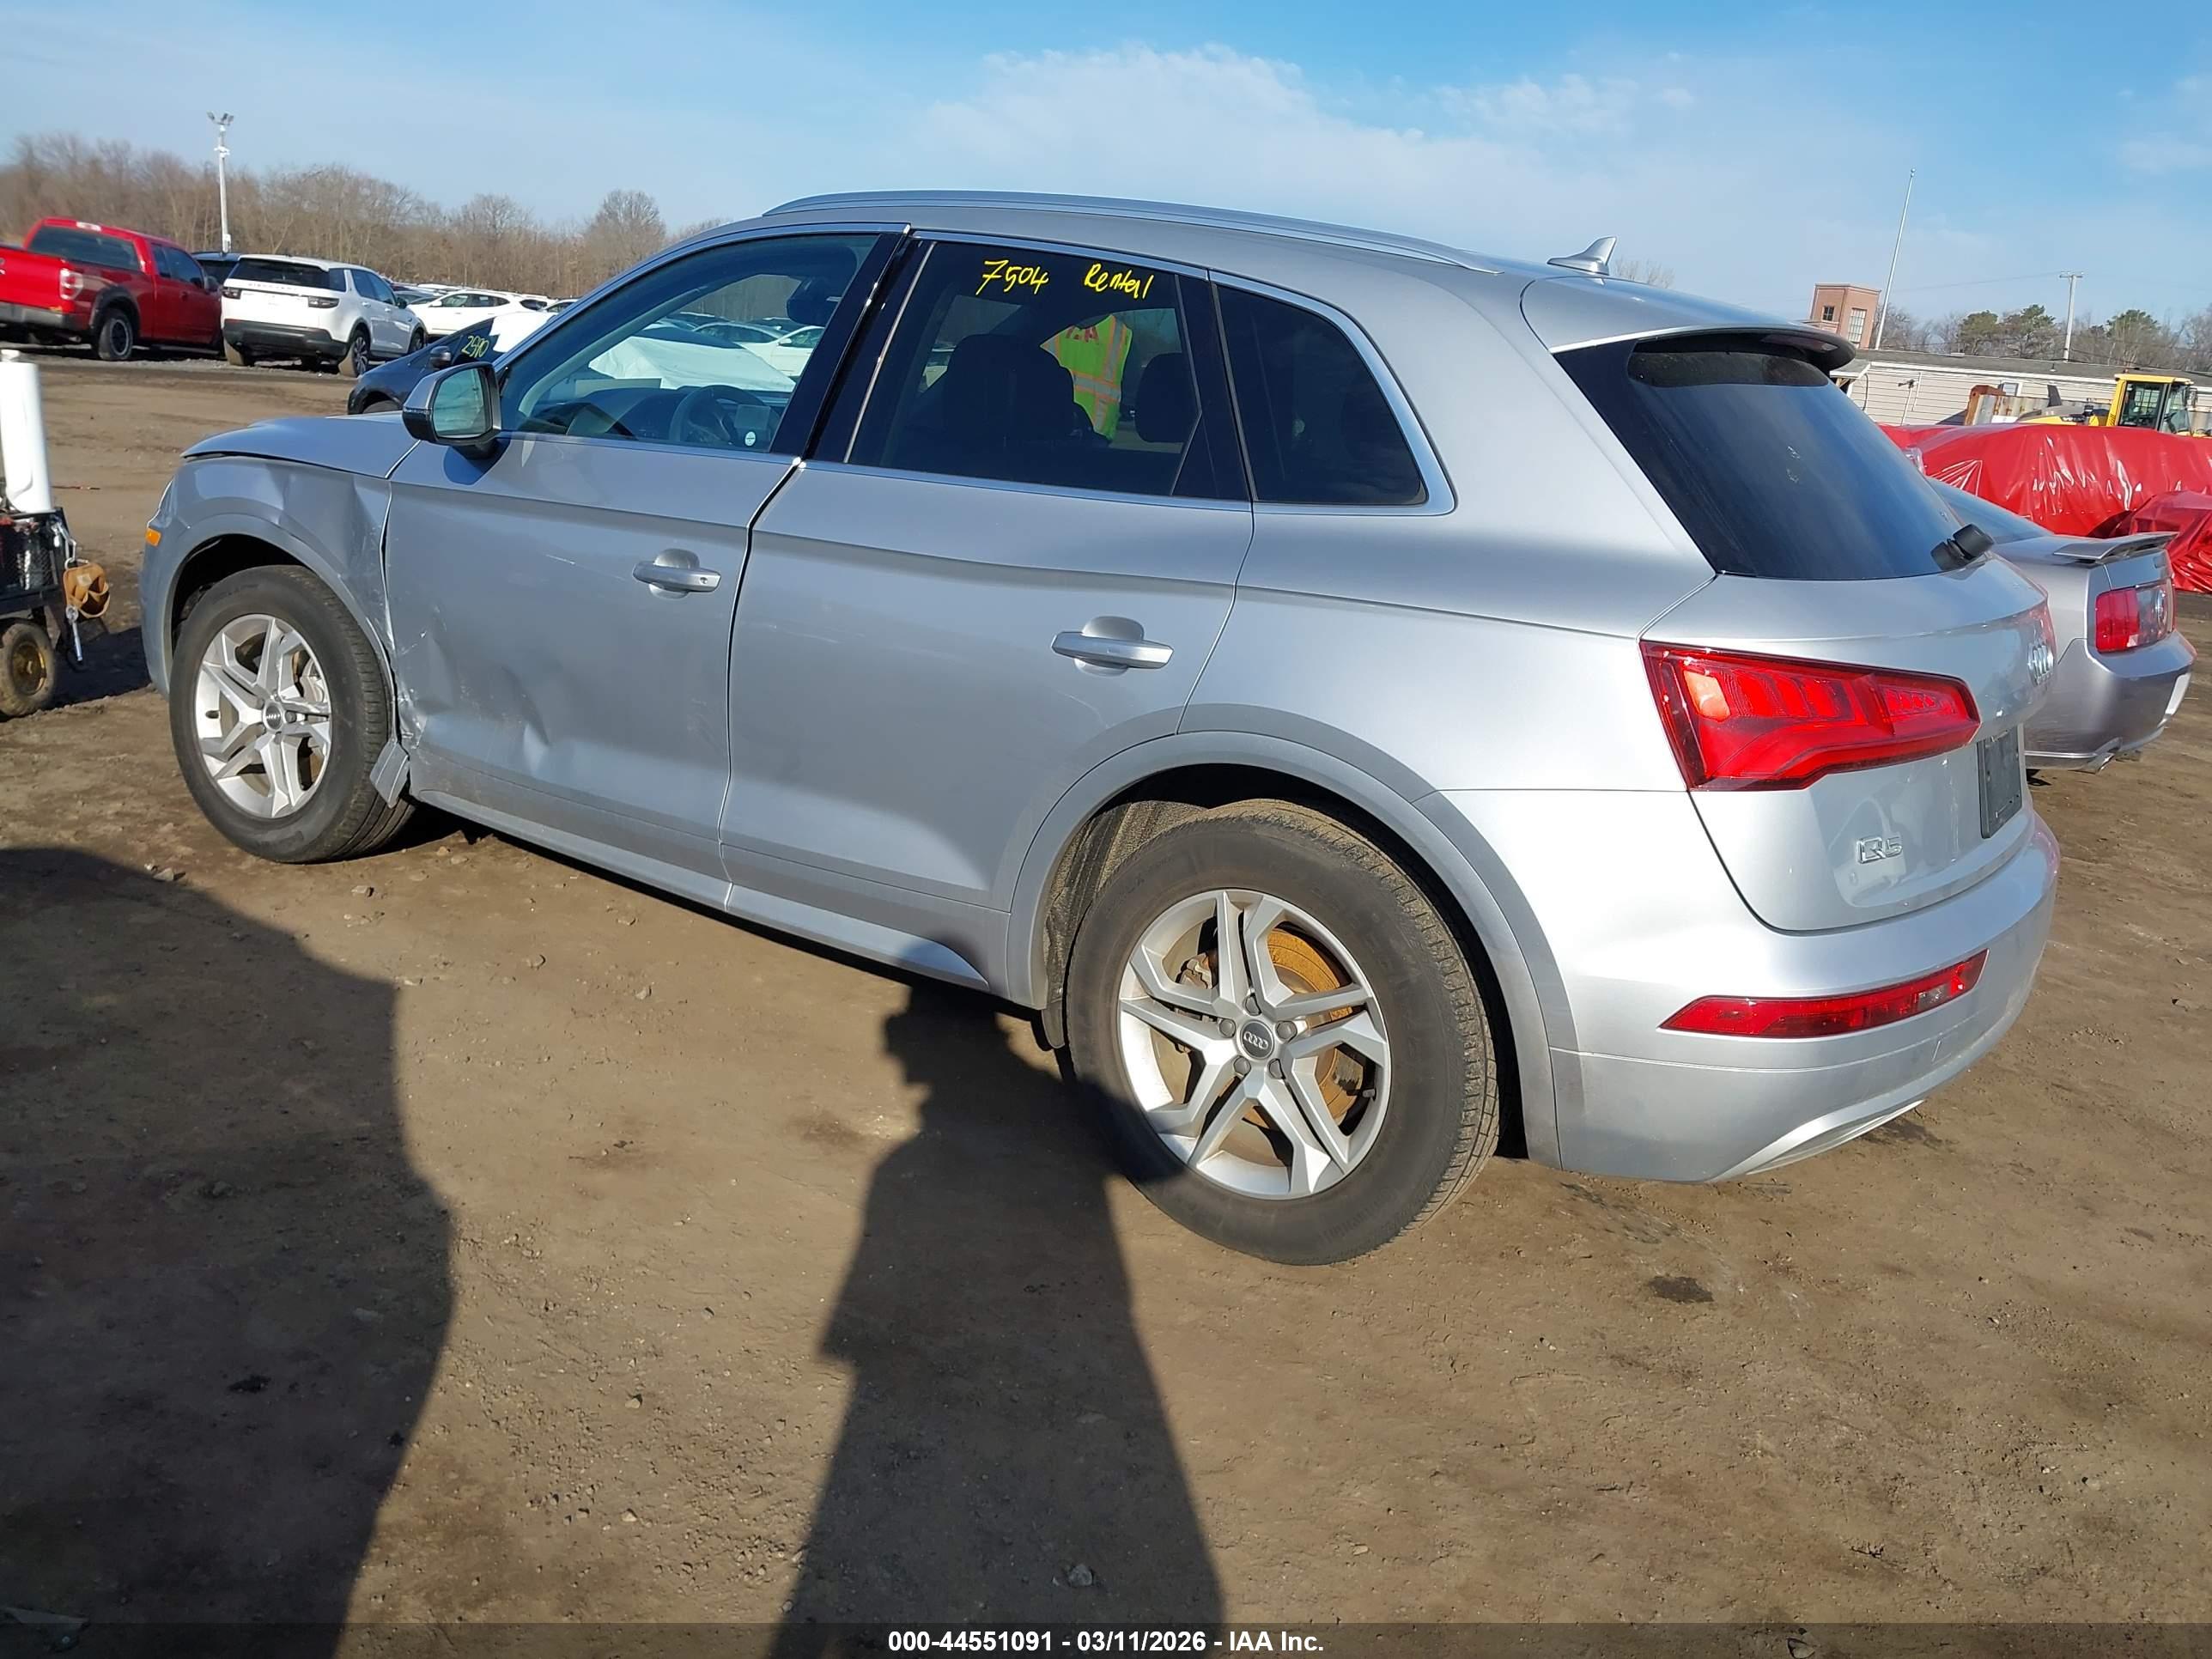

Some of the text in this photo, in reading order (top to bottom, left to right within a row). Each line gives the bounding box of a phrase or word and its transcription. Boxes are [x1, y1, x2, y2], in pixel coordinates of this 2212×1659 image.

[975, 259, 1155, 299] 7504 Rental
[1856, 836, 1903, 865] Q5
